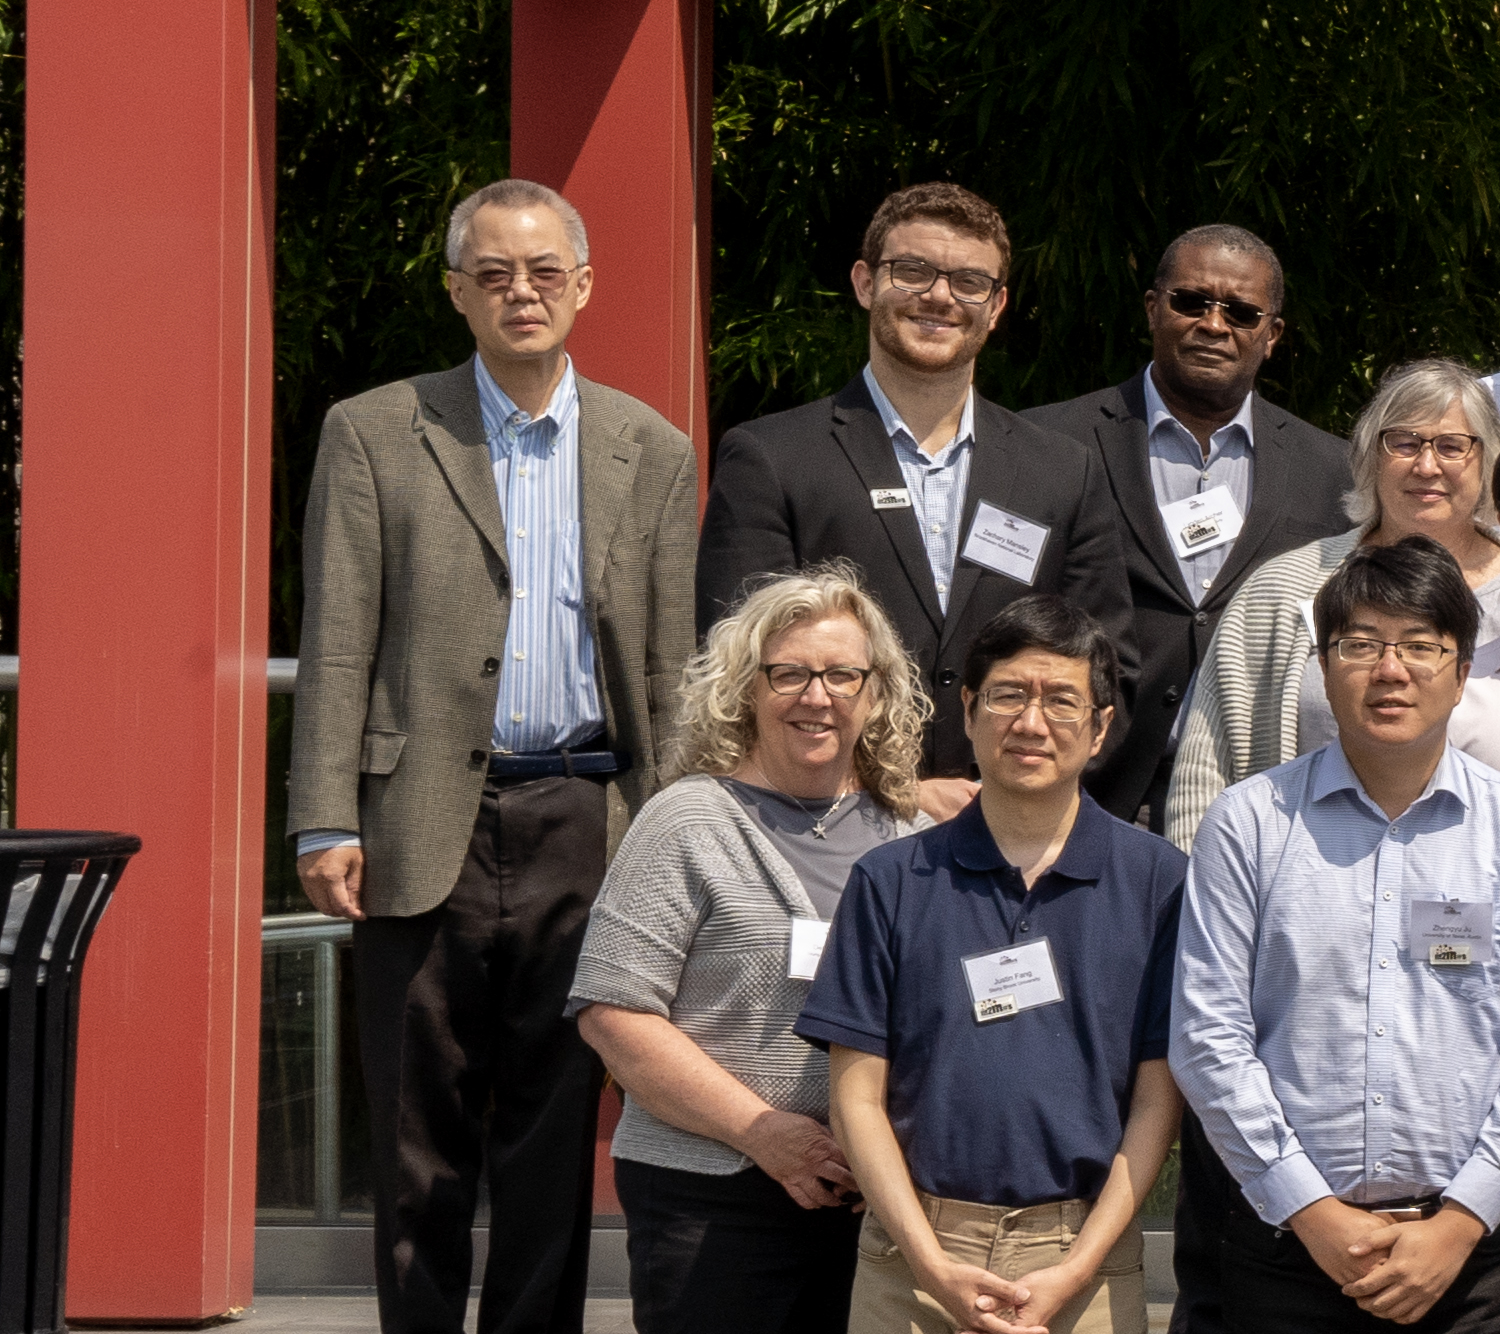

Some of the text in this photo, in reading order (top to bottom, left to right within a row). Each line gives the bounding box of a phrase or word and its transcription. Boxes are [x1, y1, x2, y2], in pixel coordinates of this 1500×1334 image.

[982, 528, 1007, 544] Zachary
[993, 970, 1033, 985] Justin Fang
